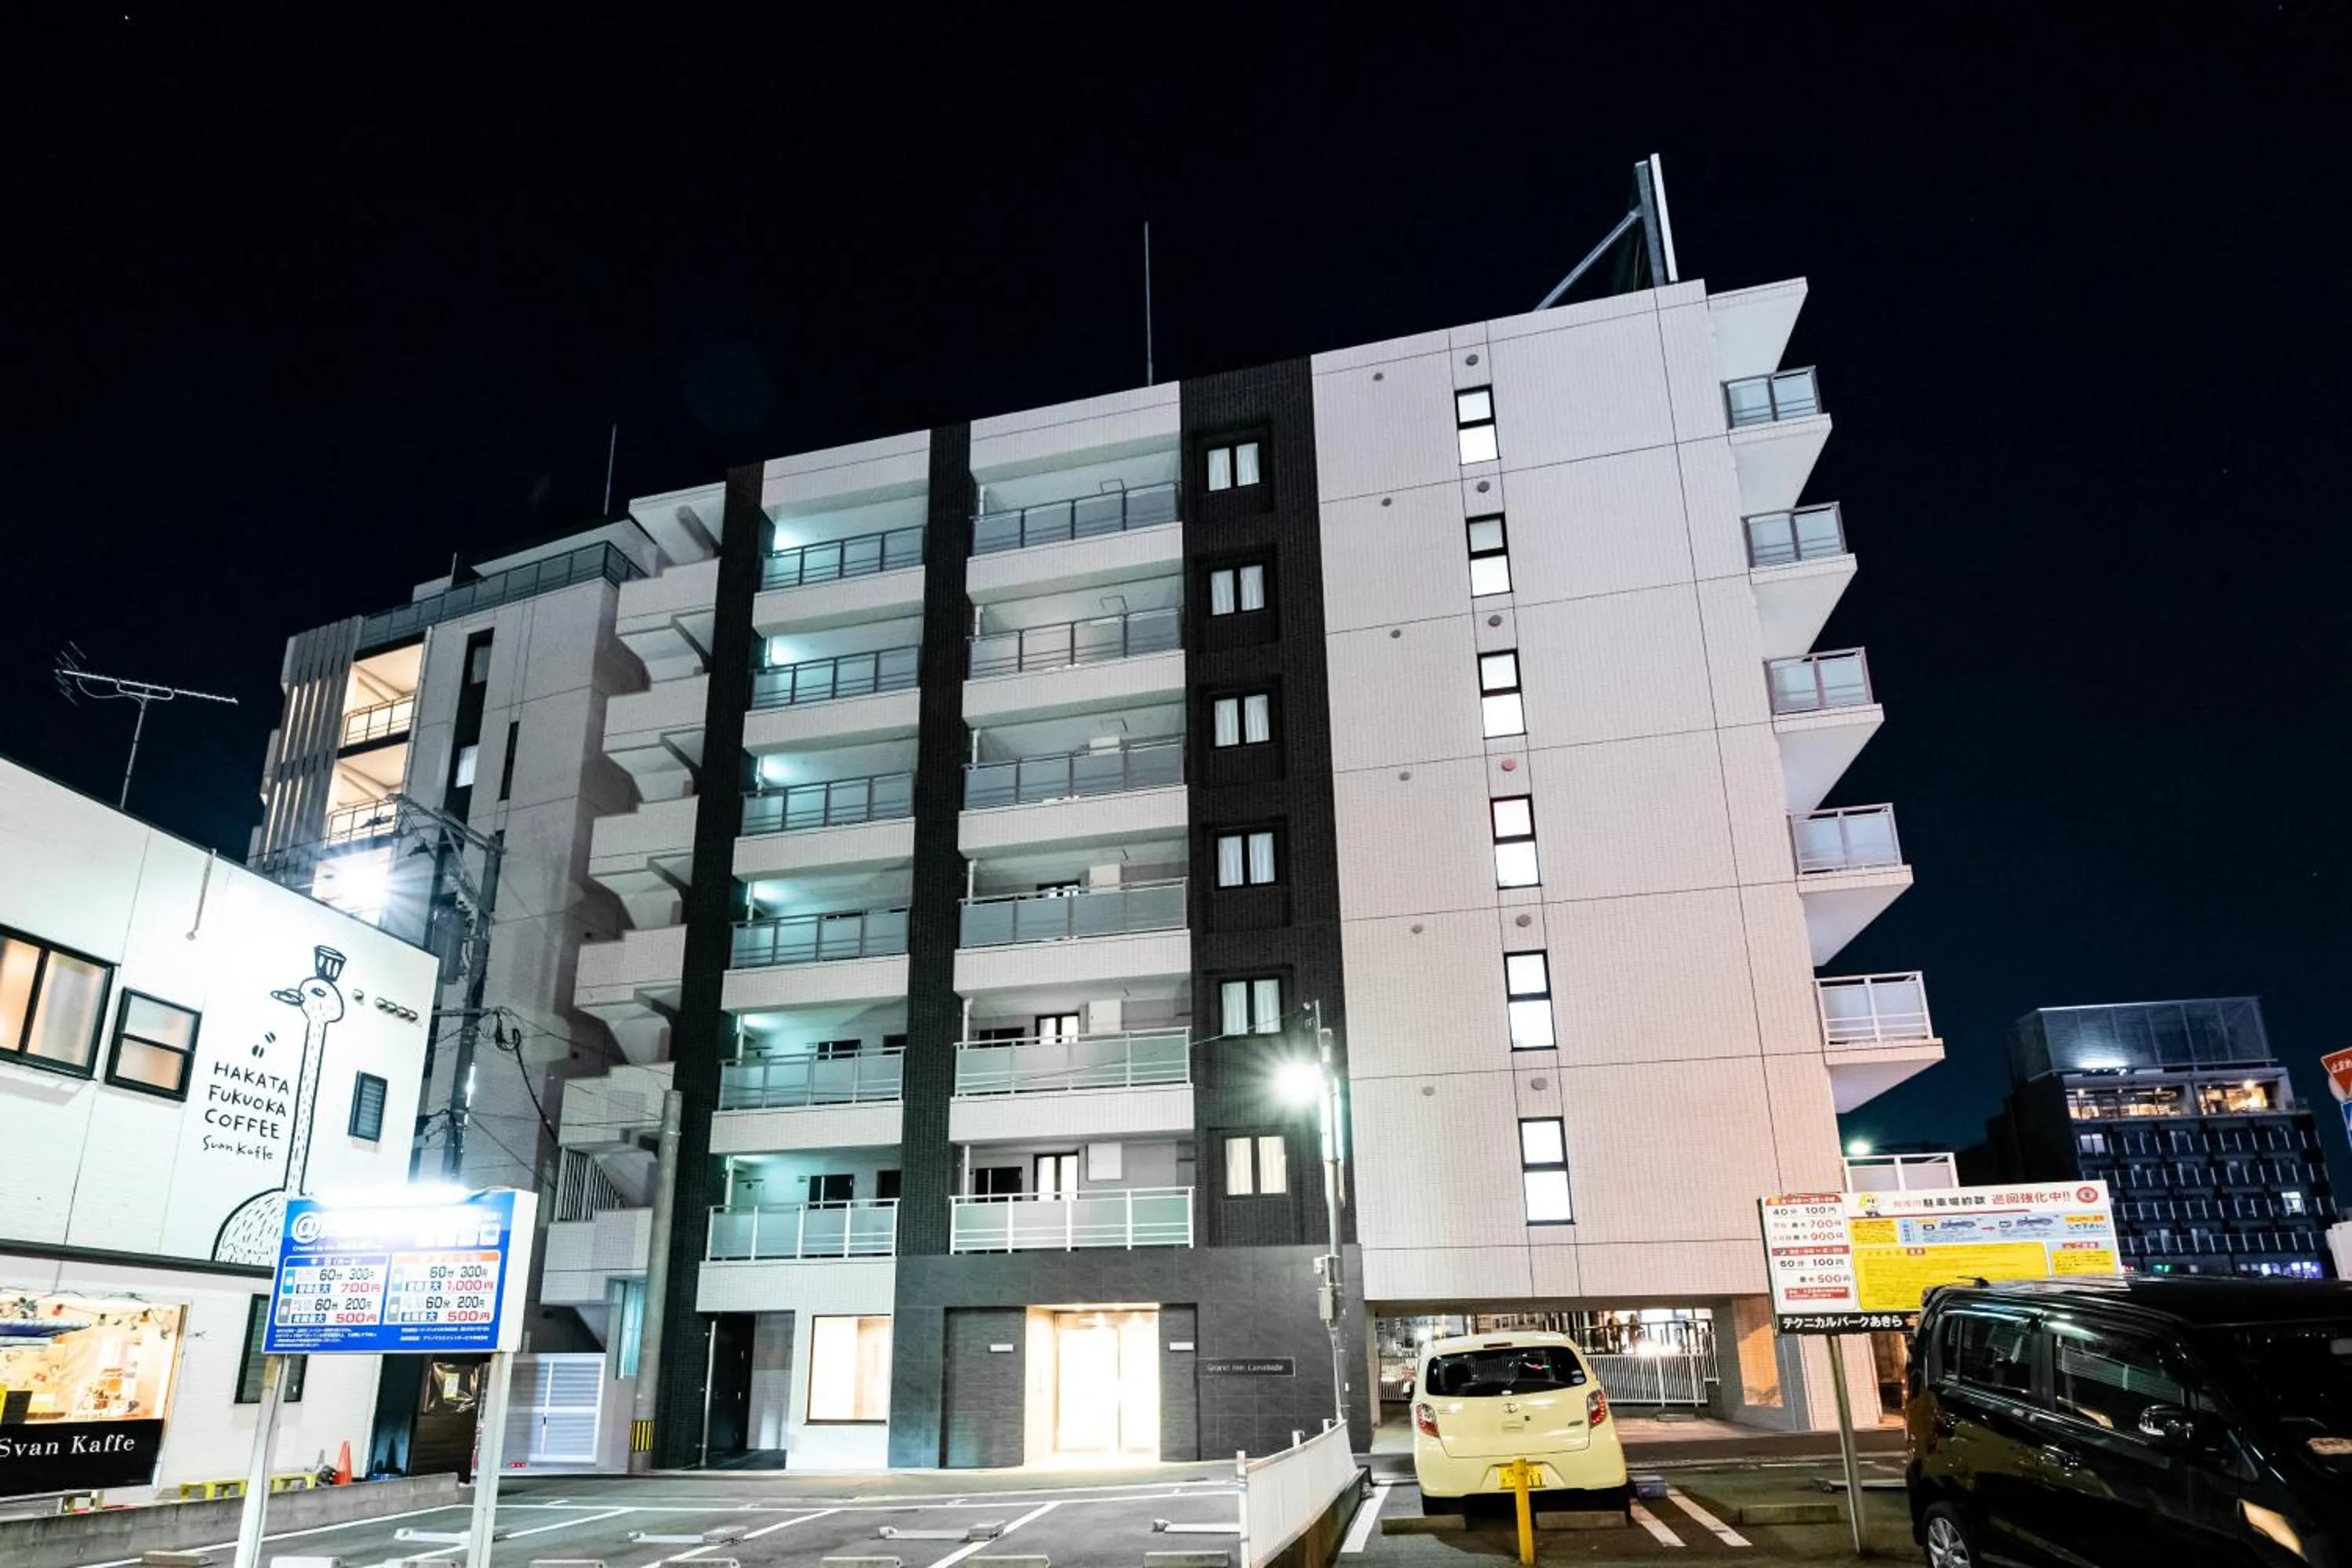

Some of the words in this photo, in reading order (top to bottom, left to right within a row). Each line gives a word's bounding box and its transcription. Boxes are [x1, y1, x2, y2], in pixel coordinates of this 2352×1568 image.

[213, 1061, 289, 1095] HAKATA
[208, 1083, 286, 1117] FUKUOKA
[205, 1108, 281, 1139] COFFEE
[0, 1437, 59, 1457] Svan
[70, 1434, 135, 1454] Kaffe
